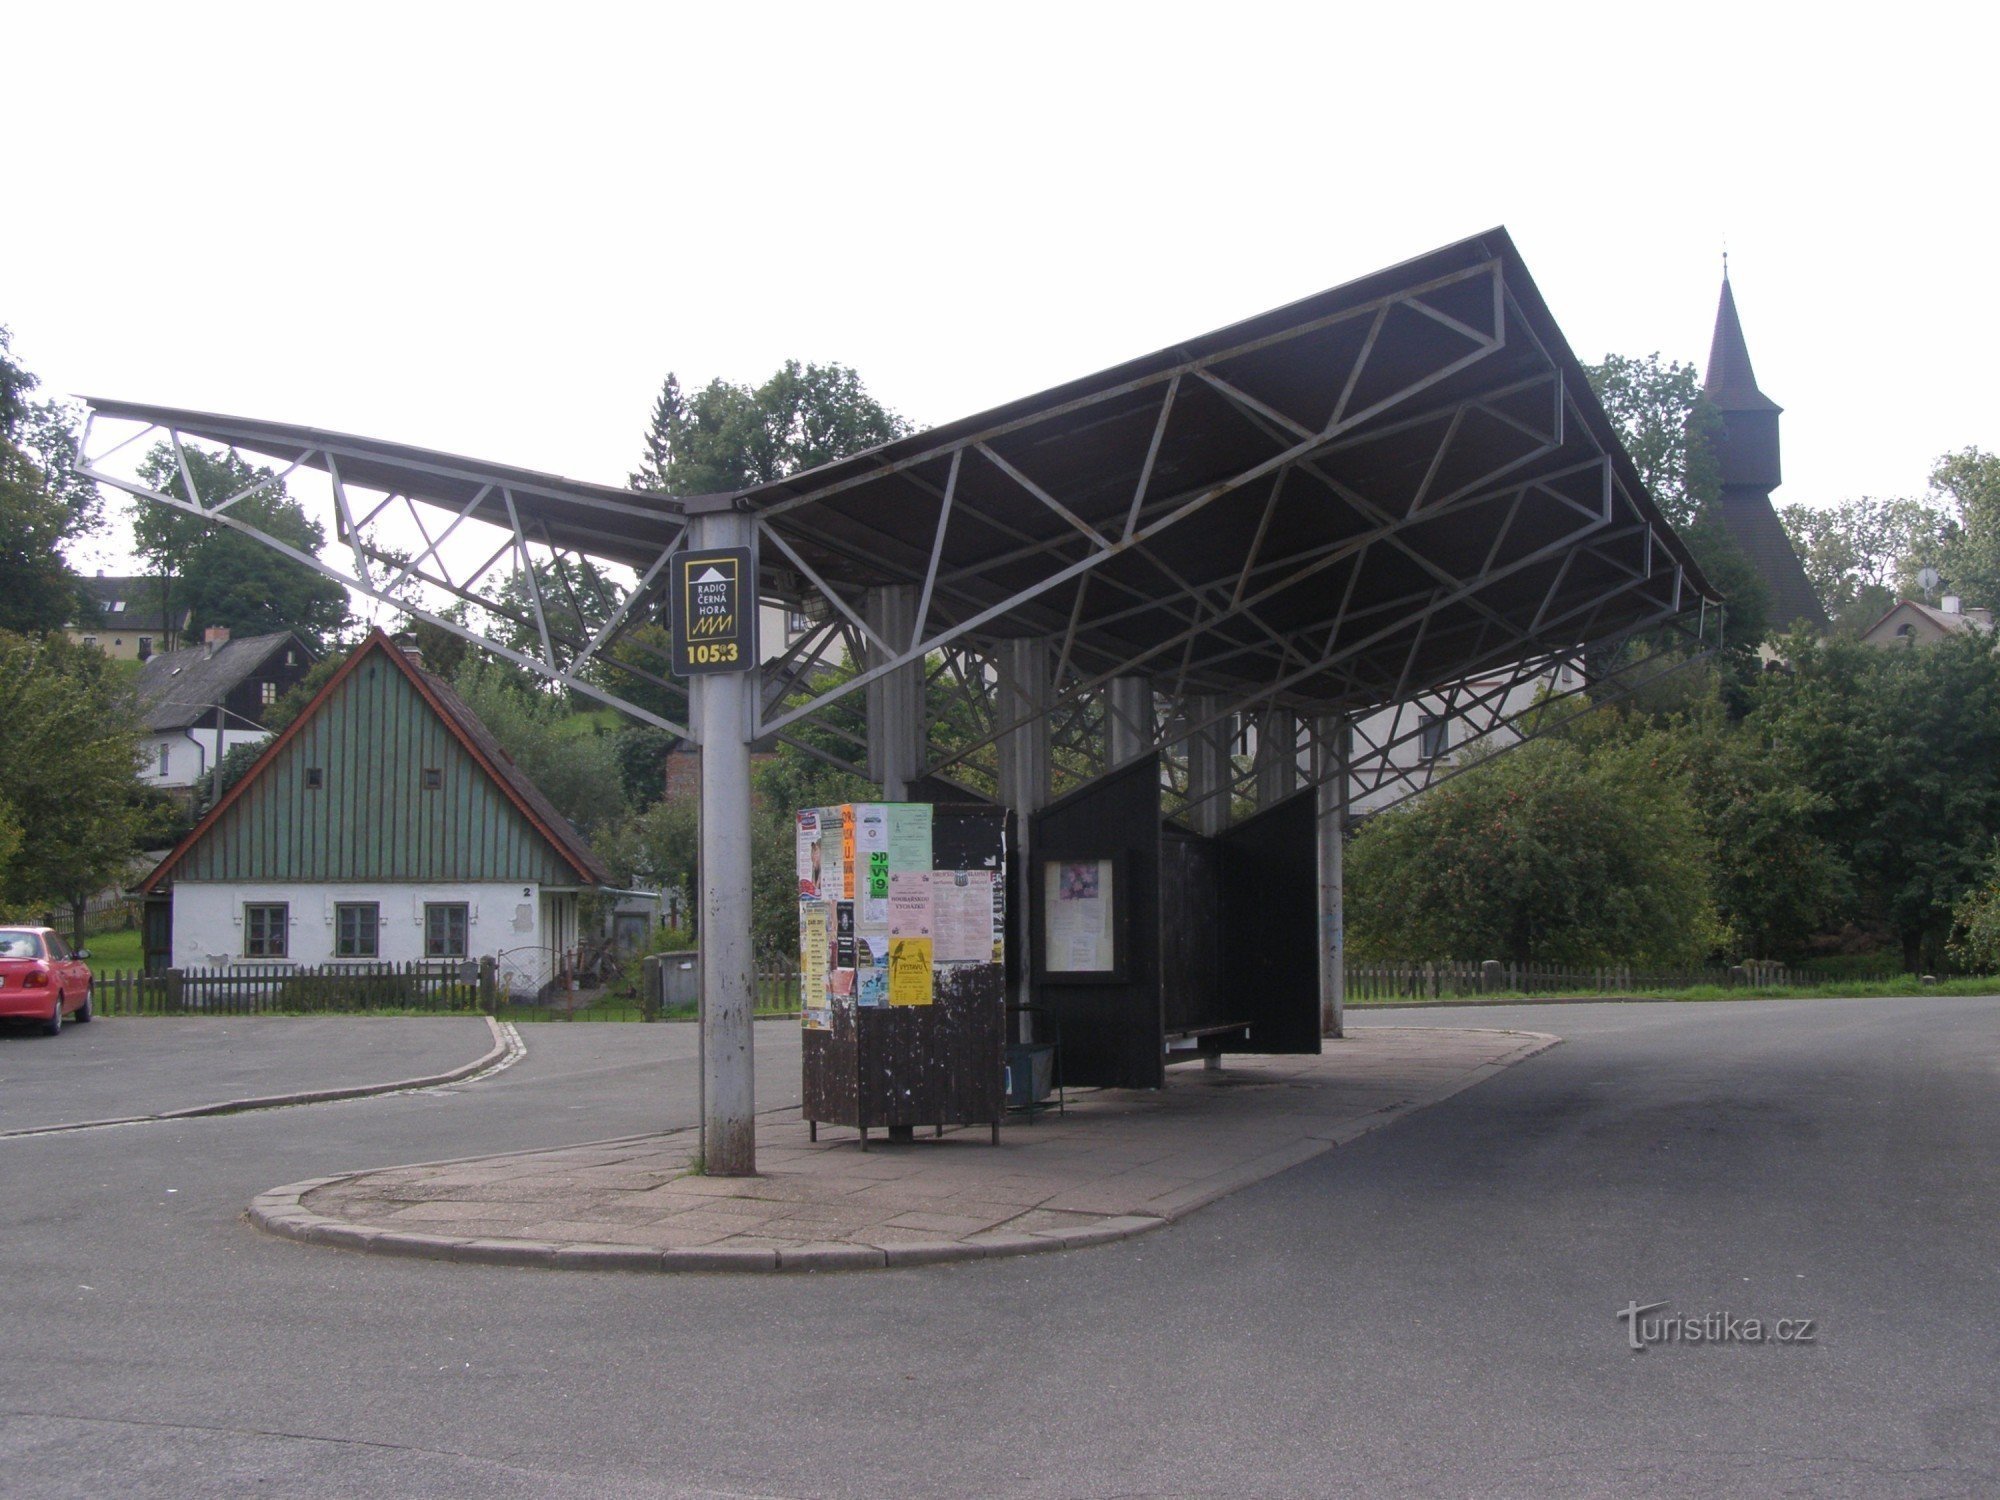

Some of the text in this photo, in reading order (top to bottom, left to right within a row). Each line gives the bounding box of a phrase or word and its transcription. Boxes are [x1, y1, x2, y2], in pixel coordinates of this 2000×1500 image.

[697, 583, 727, 593] RADIO
[697, 592, 727, 605] ČERNÁ
[699, 605, 727, 616] HORA
[687, 642, 738, 664] 105.3
[523, 887, 531, 897] 2
